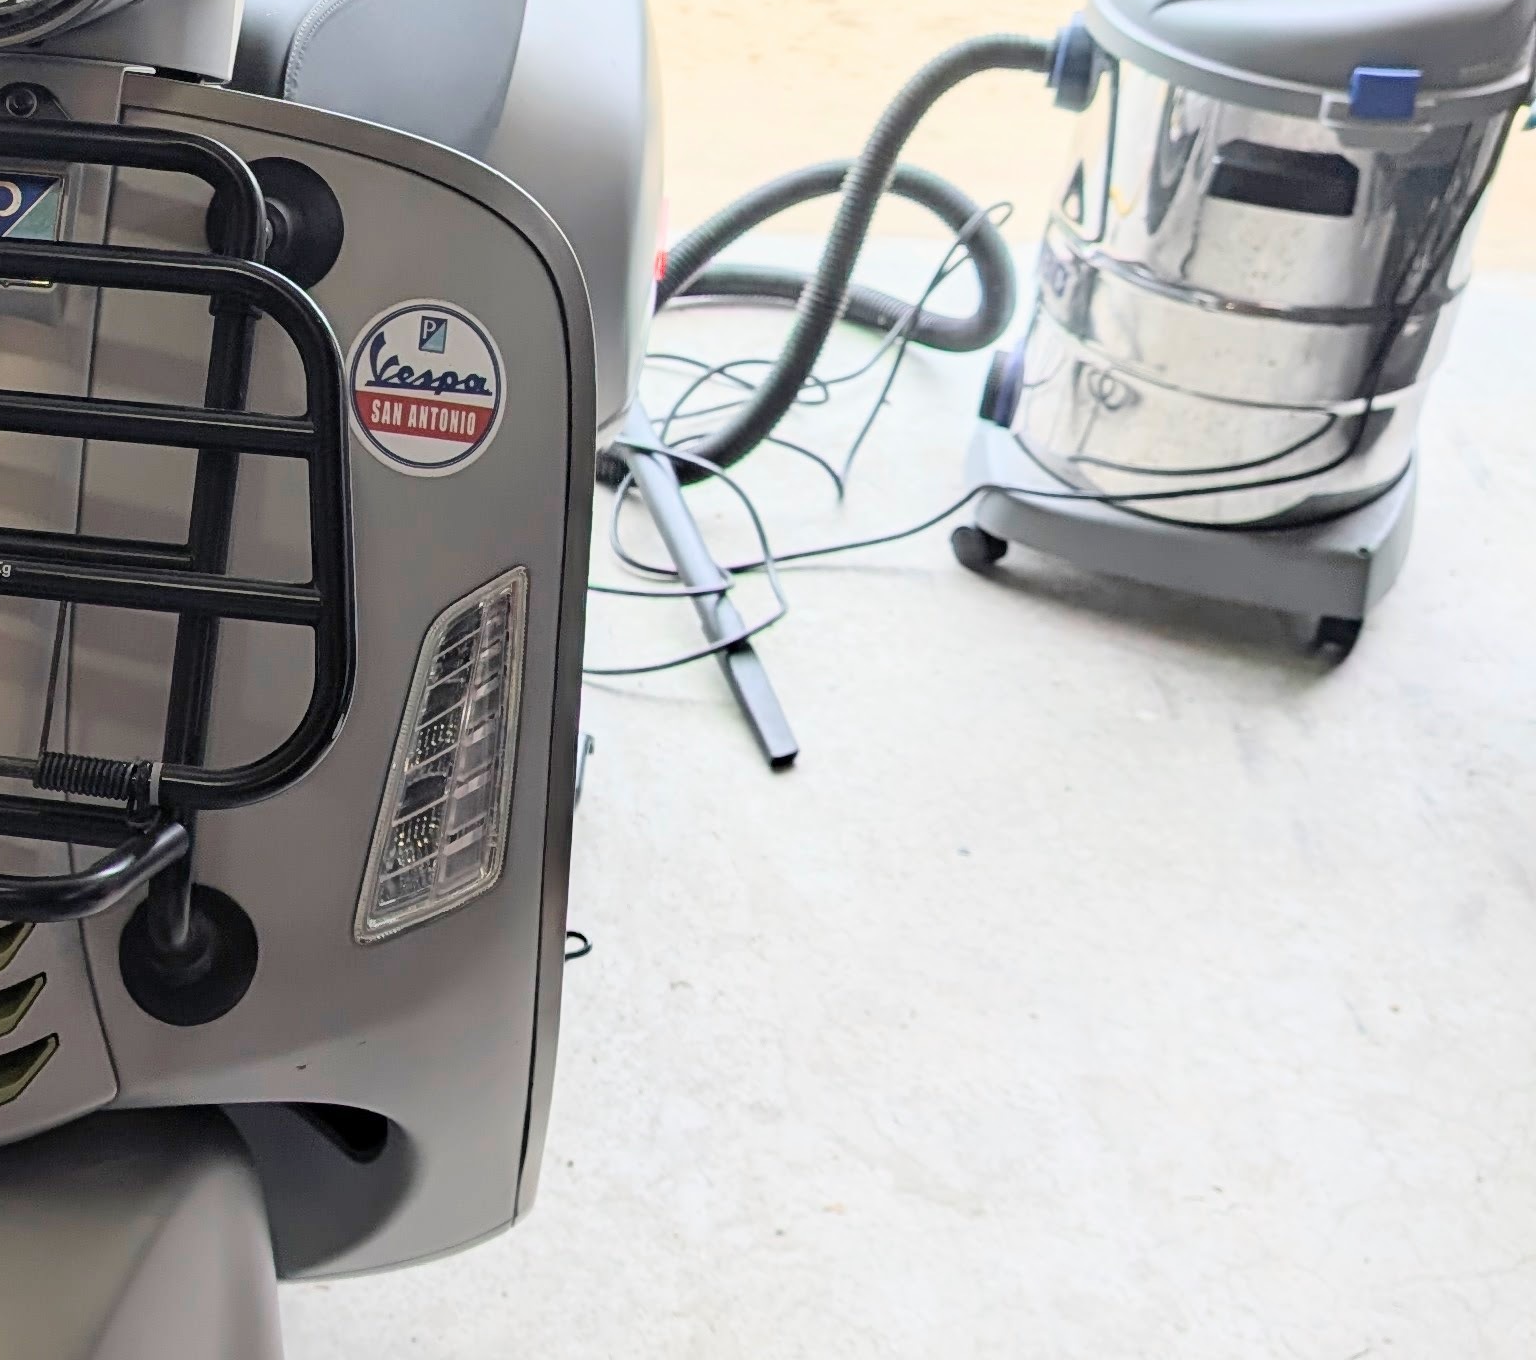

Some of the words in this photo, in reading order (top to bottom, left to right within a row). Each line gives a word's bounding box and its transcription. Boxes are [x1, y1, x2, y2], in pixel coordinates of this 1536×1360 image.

[422, 319, 437, 340] P
[365, 330, 493, 396] Vespa
[371, 399, 403, 426] SAN
[407, 404, 477, 437] ANTONIO
